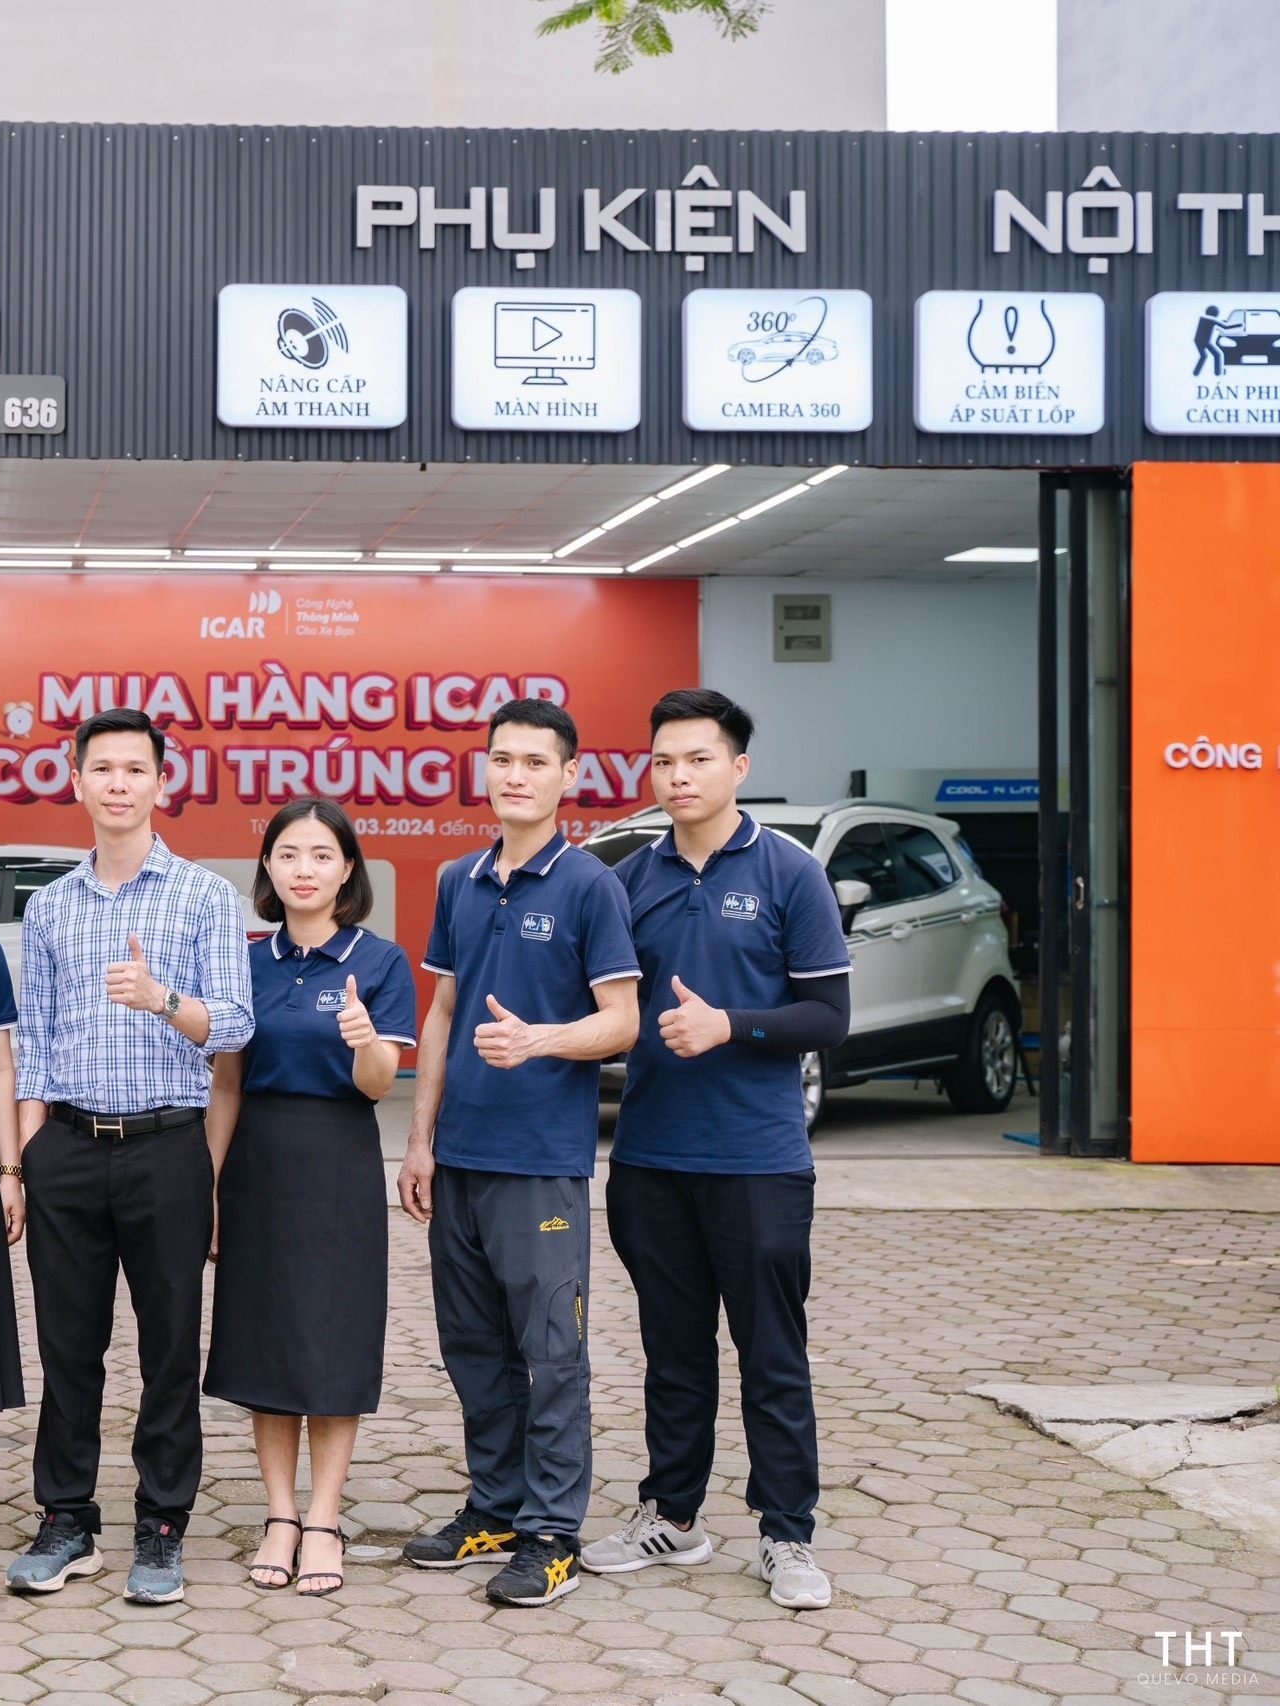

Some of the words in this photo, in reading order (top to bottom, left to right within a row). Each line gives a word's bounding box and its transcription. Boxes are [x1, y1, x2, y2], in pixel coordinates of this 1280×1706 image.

[356, 185, 556, 269] PHỤ
[584, 165, 807, 272] KIỆN
[993, 165, 1153, 274] NỘI
[259, 374, 320, 393] NÂNG
[327, 374, 366, 393] CẤP
[965, 380, 1008, 400] CẢM
[1015, 381, 1061, 400] BIẾN
[1197, 381, 1238, 400] DÁN
[4, 397, 58, 429] 636
[256, 397, 288, 416] ÂM
[294, 401, 370, 417] THANH
[494, 397, 539, 416] MÀN
[546, 398, 598, 417] HÌNH
[721, 402, 804, 418] CAMERA
[809, 402, 841, 418] 360
[950, 404, 976, 422] ÁP
[981, 404, 1032, 423] SUẤT
[1037, 404, 1076, 423] LỐP
[1186, 404, 1240, 423] CÁCH
[295, 598, 324, 611] Công
[296, 611, 330, 624] Thông
[331, 611, 360, 623] Minh
[200, 616, 266, 639] ICAR
[296, 625, 318, 636] Cho
[319, 626, 333, 636] Xe
[40, 673, 198, 725] MUA
[207, 661, 397, 726] HÀNG
[1164, 735, 1263, 769] CÔNG
[224, 736, 454, 799] TRÚNG
[946, 785, 989, 795] COOL
[993, 785, 1006, 795] N
[439, 817, 475, 836] đến
